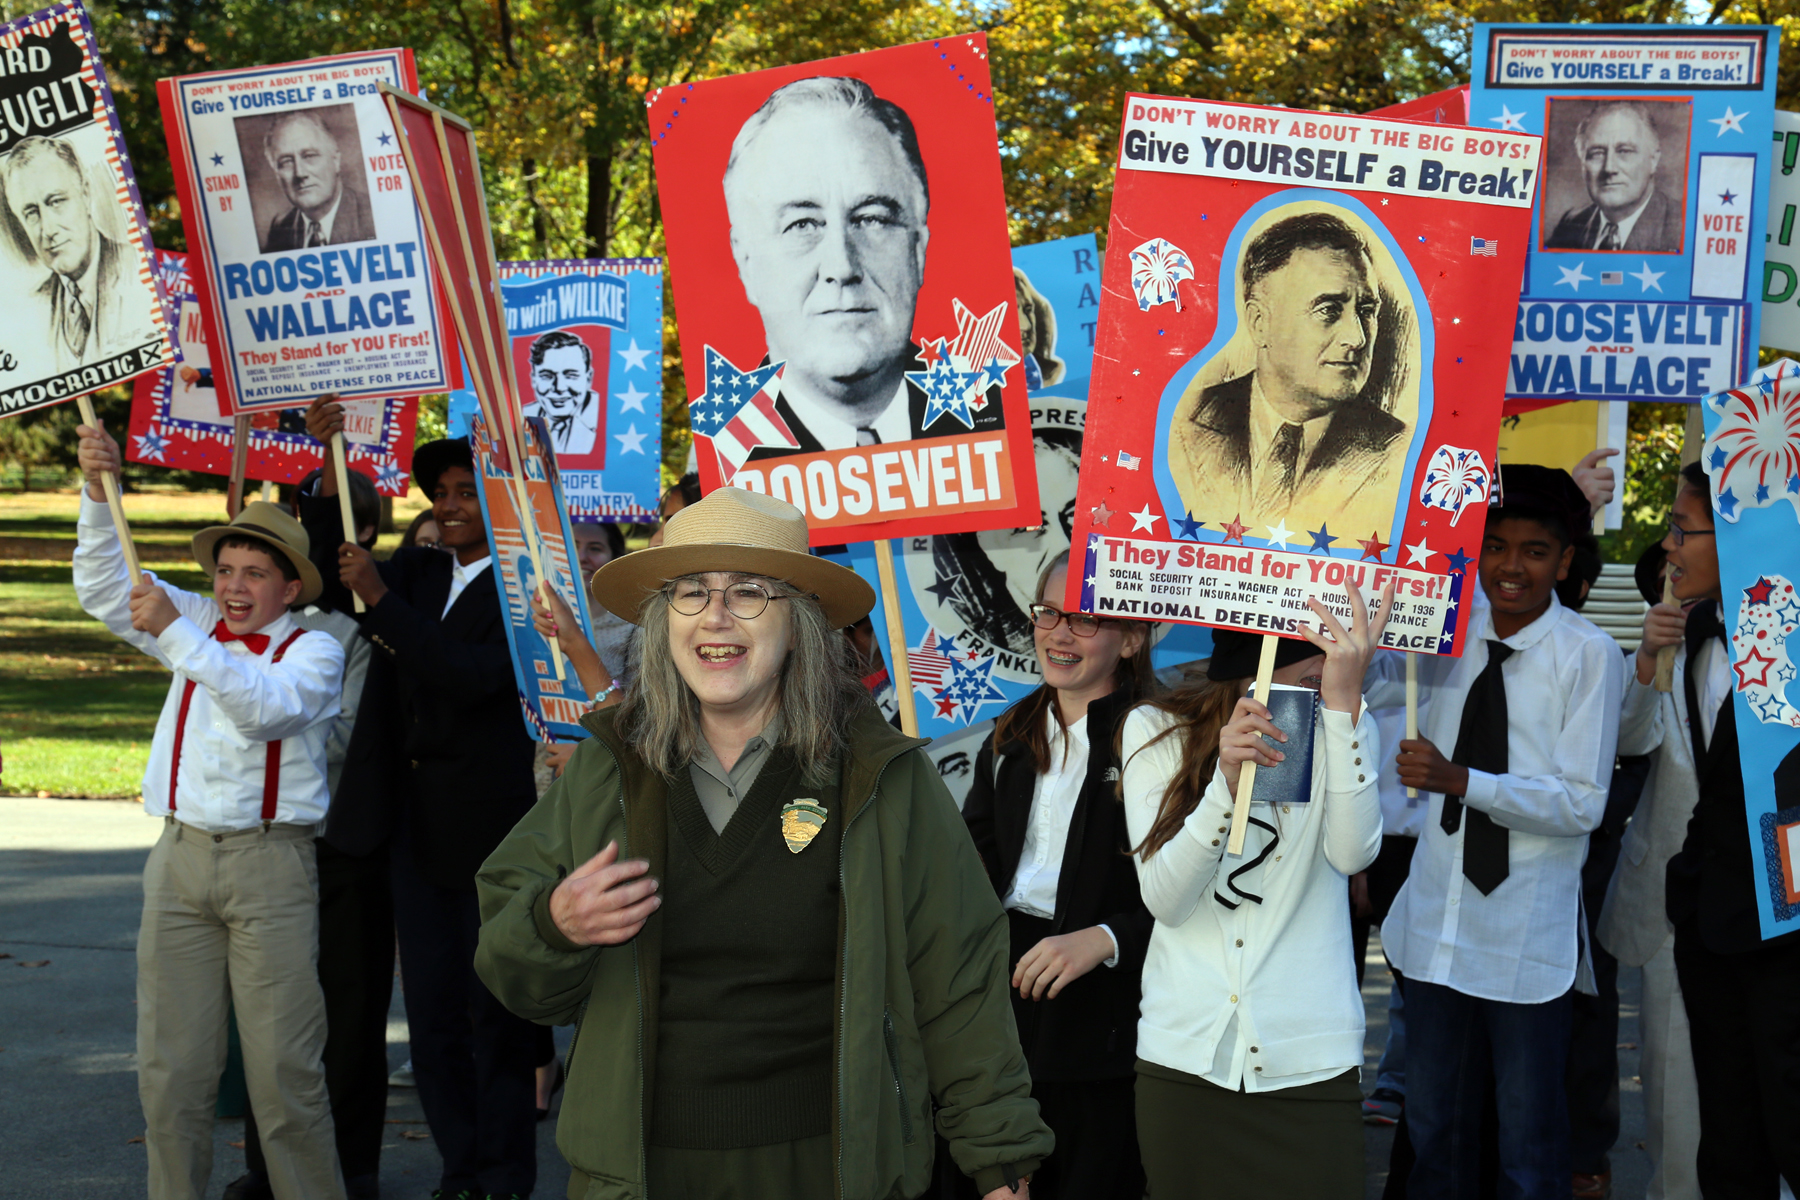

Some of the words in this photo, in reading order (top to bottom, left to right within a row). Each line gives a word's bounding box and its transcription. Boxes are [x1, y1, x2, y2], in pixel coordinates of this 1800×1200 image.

[1510, 49, 1547, 58] DON'T
[1552, 49, 1595, 59] WORRY
[1601, 50, 1642, 59] ABOUT
[1648, 50, 1670, 59] THE
[1675, 50, 1696, 60] BIG
[1702, 50, 1740, 60] BOYS!
[192, 85, 223, 97] DON'T
[228, 80, 265, 93] WORRY
[269, 76, 304, 88] ABOUT
[308, 73, 328, 83] THE
[332, 70, 349, 80] BIG
[353, 66, 386, 77] BOYS!
[1506, 61, 1544, 79] Give
[1550, 62, 1654, 80] YOURSELF
[1660, 68, 1670, 80] a
[1678, 64, 1743, 81] Break!
[191, 99, 225, 116] Give
[228, 86, 316, 111] YOURSELF
[323, 88, 333, 100] a
[1132, 104, 1196, 126] DON'T
[1205, 111, 1280, 135] WORRY
[1288, 120, 1361, 144] ABOUT
[1370, 129, 1409, 149] THE
[1418, 133, 1454, 153] BIG
[1463, 138, 1531, 161] BOYS!
[368, 153, 404, 172] VOTE
[1124, 129, 1189, 166] Give
[1201, 136, 1379, 184] YOURSELF
[1387, 166, 1406, 189] a
[1418, 159, 1533, 200] Break!
[205, 174, 240, 193] STAND
[376, 175, 403, 193] FOR
[219, 195, 233, 212] BY
[1703, 214, 1744, 233] VOTE
[1706, 237, 1737, 256] FOR
[223, 241, 417, 300] ROOSEVELT
[303, 288, 346, 300] AND
[520, 288, 557, 330] with
[558, 281, 625, 323] WILLKIE
[245, 289, 416, 343] WALLACE
[239, 350, 277, 367] They
[281, 342, 323, 361] Stand
[326, 341, 349, 356] for
[351, 335, 385, 353] YOU
[388, 330, 430, 349] First!
[1585, 345, 1635, 354] AND
[0, 354, 135, 412] MOCRATIC
[244, 383, 306, 398] NATIONAL
[310, 376, 365, 391] DEFENSE
[369, 373, 393, 385] FOR
[397, 369, 437, 381] PEACE
[1510, 354, 1711, 397] WALLACE
[560, 474, 599, 489] HOPE
[1104, 538, 1171, 570] They
[1177, 545, 1254, 575] Stand
[1261, 553, 1301, 580] for
[1307, 558, 1367, 589] YOU
[1372, 567, 1447, 601] First!
[1109, 568, 1143, 581] SOCIAL
[1149, 572, 1194, 585] SECURITY
[1199, 576, 1218, 587] ACT
[1238, 580, 1279, 595] WAGNER
[1283, 586, 1303, 598] ACT
[1321, 592, 1352, 606] HOUSI
[1369, 598, 1382, 609] AC
[1393, 601, 1406, 612] OF
[1413, 604, 1435, 616] 1936
[1115, 581, 1144, 593] BANK
[1151, 584, 1193, 597] DEPOSIT
[1199, 588, 1259, 604] INSURANCE
[1099, 597, 1206, 620] NATIONAL
[1215, 608, 1311, 634] DEFENS
[1379, 631, 1438, 649] EACE
[539, 680, 563, 694] WANT
